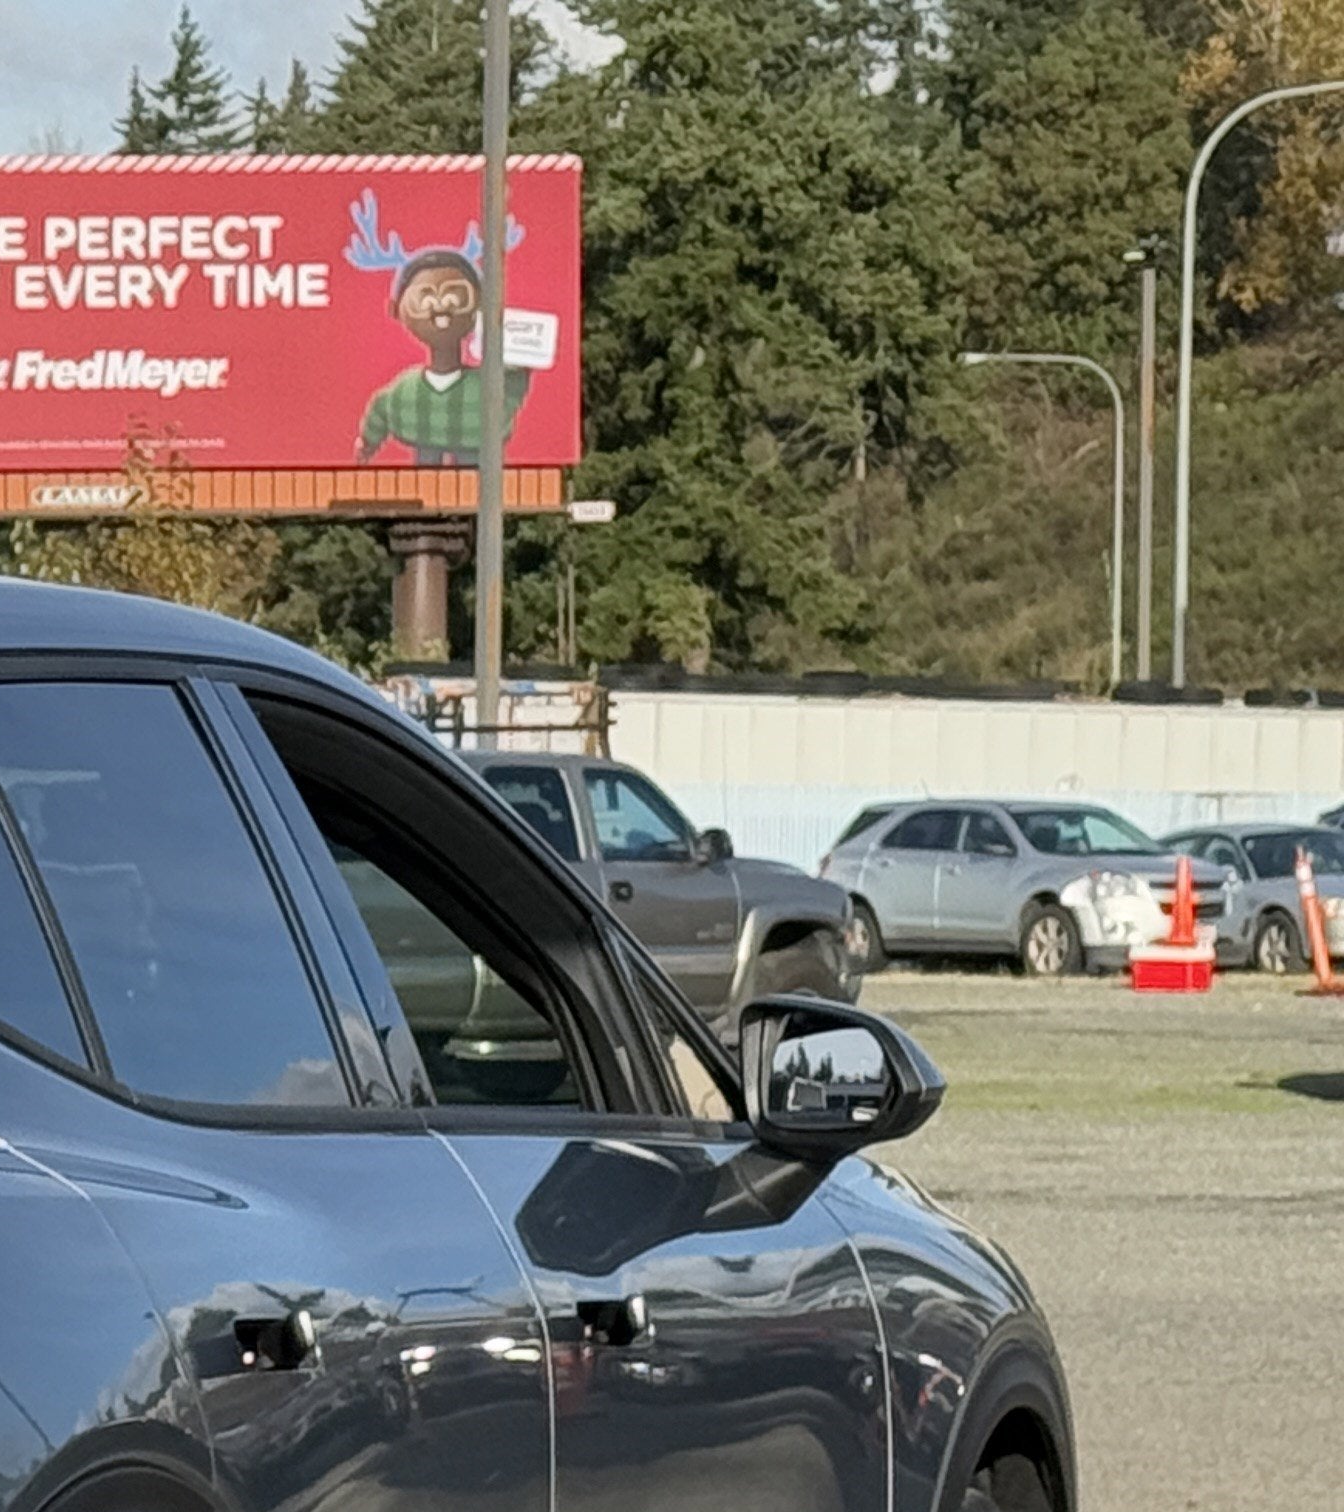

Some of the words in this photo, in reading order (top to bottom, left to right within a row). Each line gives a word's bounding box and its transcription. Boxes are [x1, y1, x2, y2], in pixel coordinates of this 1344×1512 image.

[43, 215, 284, 260] PERFECT
[14, 264, 189, 310] EVERY
[203, 263, 331, 308] TIME
